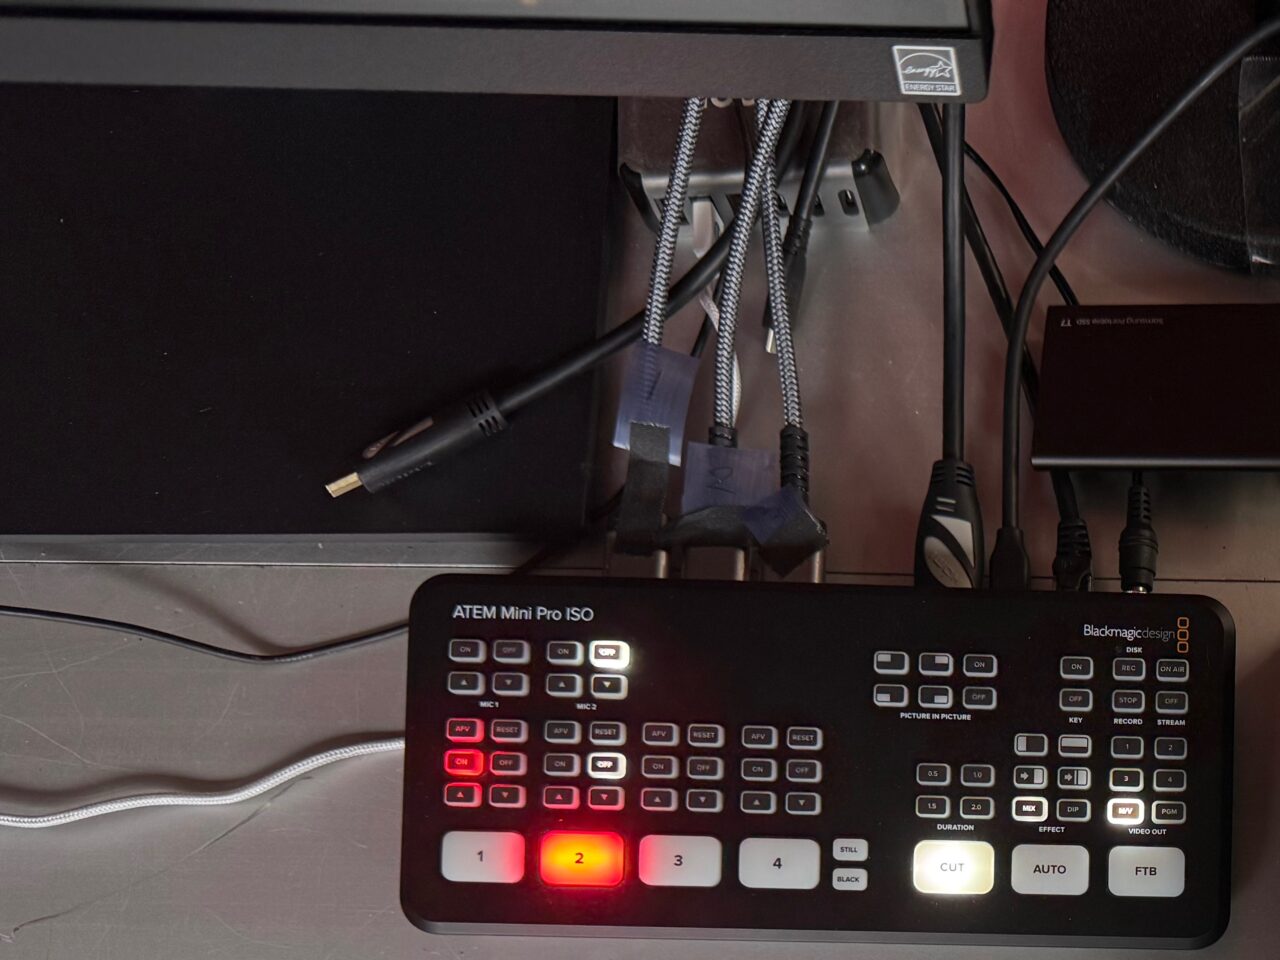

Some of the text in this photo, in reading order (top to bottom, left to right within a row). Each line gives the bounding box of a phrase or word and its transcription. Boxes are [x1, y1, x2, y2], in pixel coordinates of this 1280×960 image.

[1060, 318, 1072, 327] T7
[452, 605, 594, 622] ATEM Mini Pro ISO
[974, 661, 985, 669] ON
[900, 711, 931, 720] PICTURE
[941, 713, 971, 721] PICTURE
[477, 850, 483, 862] 1
[575, 852, 584, 864] 2
[673, 855, 683, 867] 3
[773, 857, 782, 869] 4
[940, 862, 964, 872] CUT
[1033, 865, 1067, 874] AUTO
[1135, 867, 1157, 876] FTB
